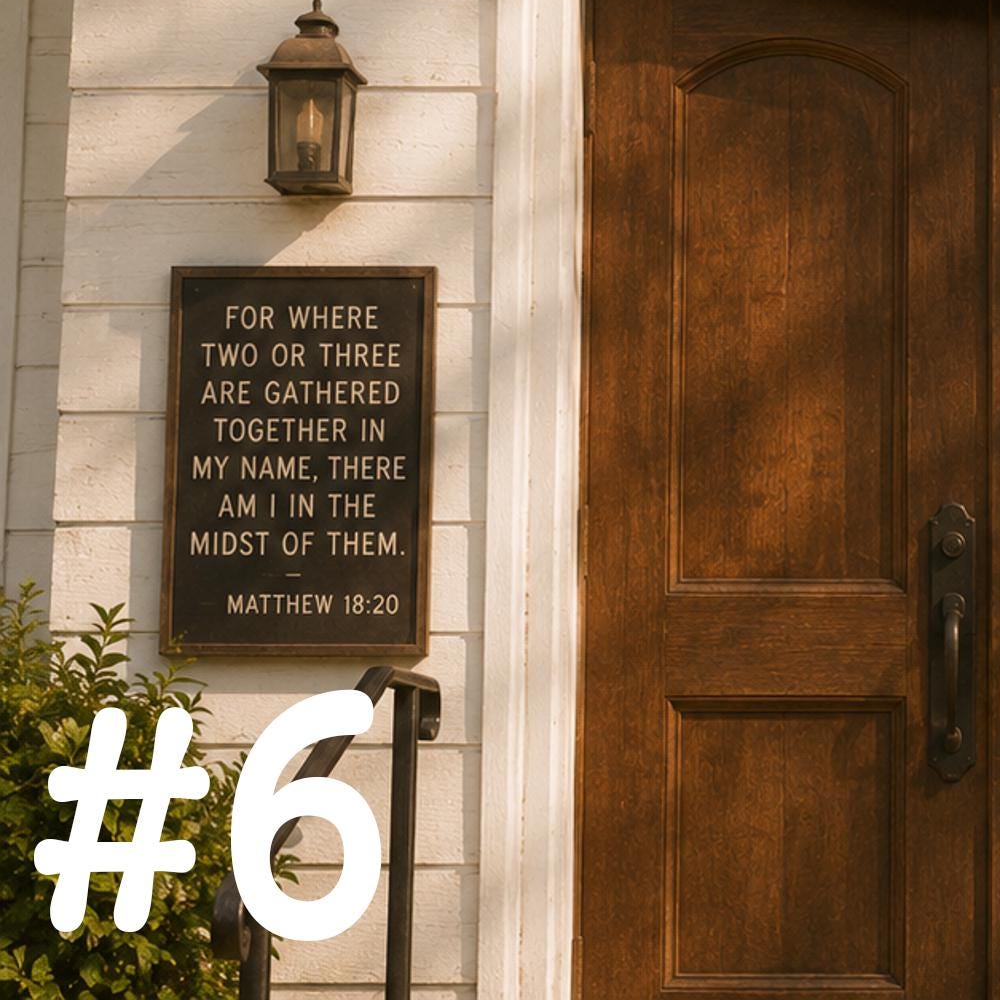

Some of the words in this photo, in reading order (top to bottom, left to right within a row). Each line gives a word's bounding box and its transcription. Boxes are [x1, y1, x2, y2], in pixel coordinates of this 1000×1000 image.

[226, 305, 274, 330] FOR
[288, 305, 378, 330] WHERE
[201, 343, 258, 368] TWO
[272, 343, 305, 368] OR
[319, 343, 401, 368] THREE
[201, 380, 251, 405] ARE
[264, 380, 400, 405] GATHERED
[214, 418, 347, 442] TOGETHER
[361, 418, 384, 442] IN
[192, 456, 229, 480] MY
[241, 456, 318, 483] NAME,
[328, 456, 406, 480] THERE
[218, 494, 256, 518] AM
[271, 494, 275, 518] I
[290, 494, 314, 518] IN
[328, 494, 375, 518] THE
[190, 531, 269, 556] MIDST
[282, 531, 315, 556] OF
[327, 531, 405, 556] THEM.
[227, 594, 333, 615] MATTHEW
[344, 594, 399, 615] 18:20
